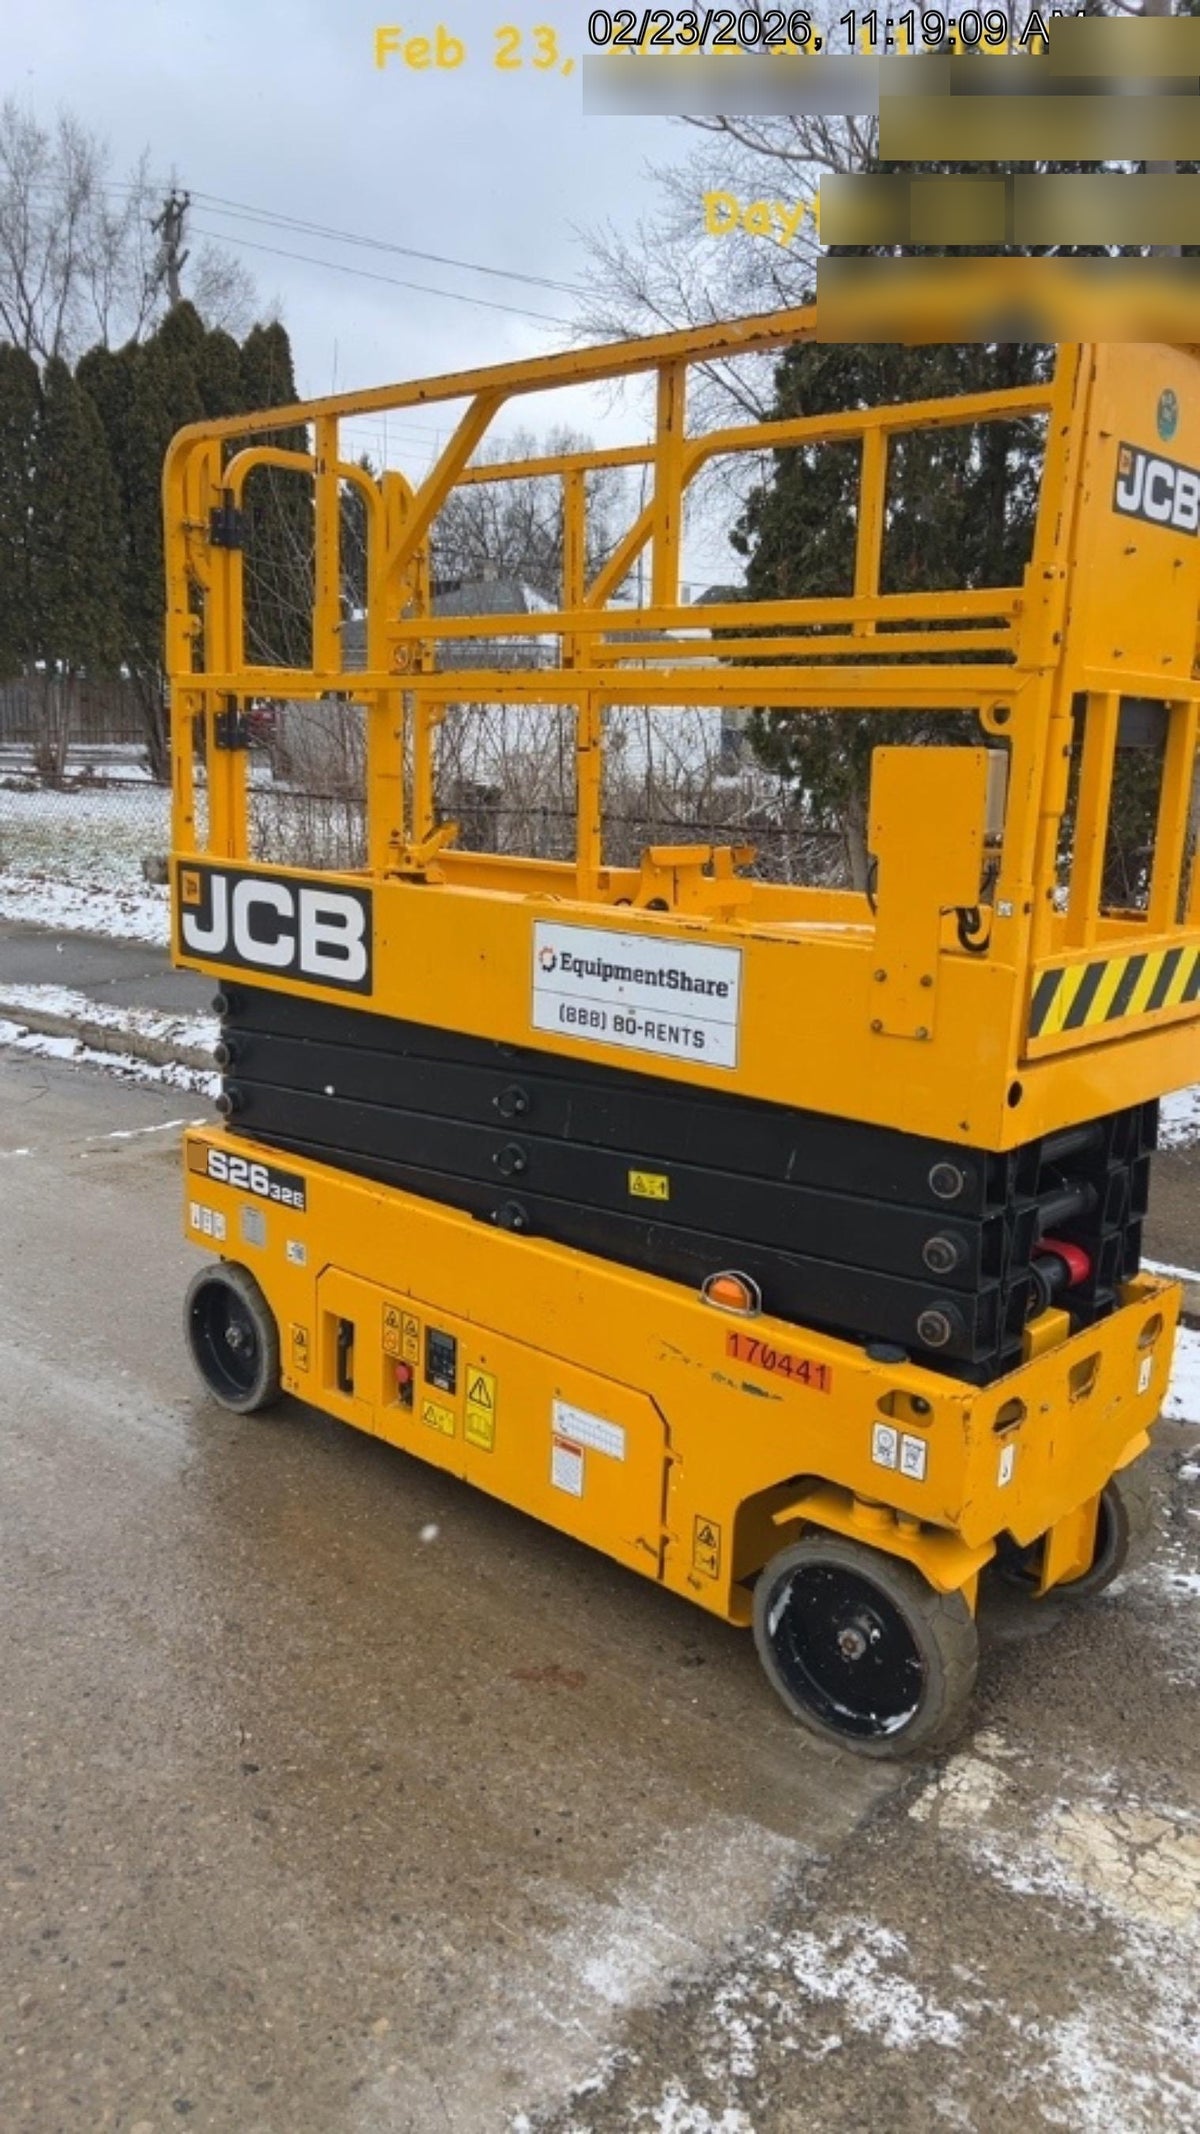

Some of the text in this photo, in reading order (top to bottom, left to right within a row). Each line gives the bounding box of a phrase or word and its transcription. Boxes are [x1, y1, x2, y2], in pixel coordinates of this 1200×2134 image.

[1116, 454, 1199, 530] JCB
[182, 874, 367, 982] JCB
[559, 952, 729, 998] EquipmentShare
[558, 1003, 706, 1049] (888) 80-RENTS
[729, 1332, 827, 1391] 170441
